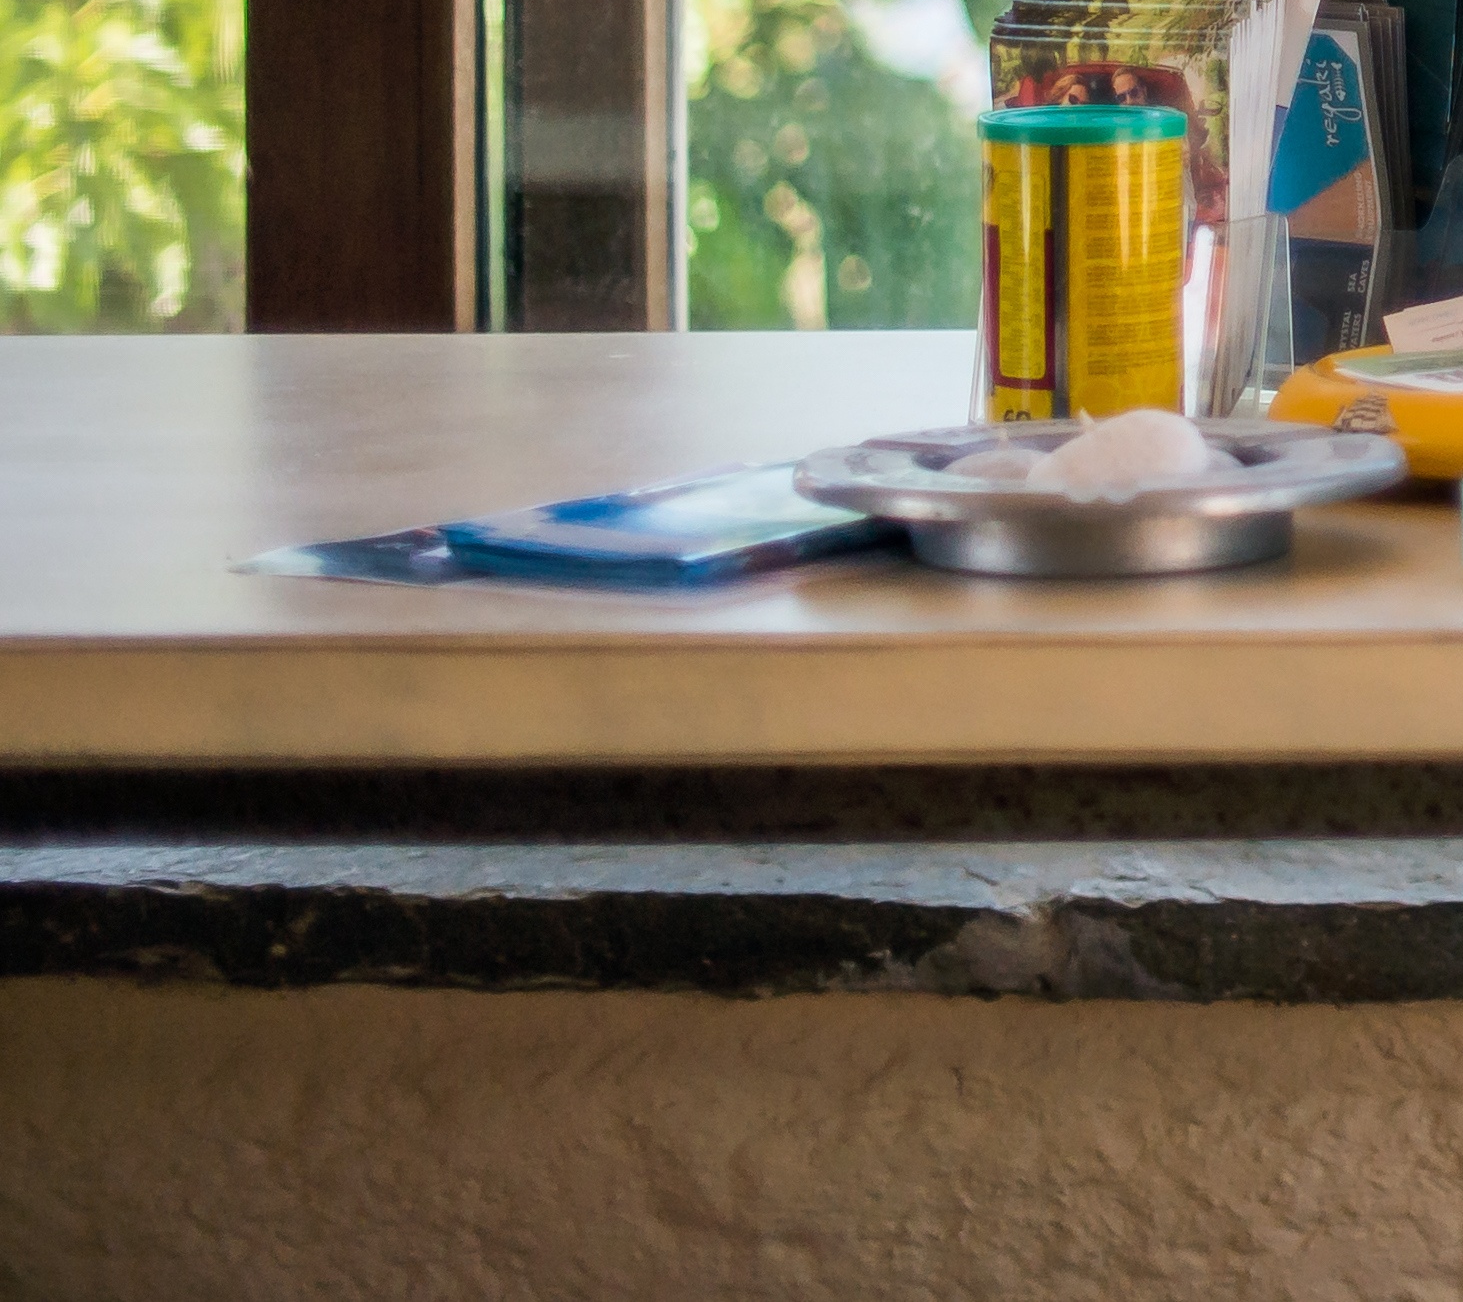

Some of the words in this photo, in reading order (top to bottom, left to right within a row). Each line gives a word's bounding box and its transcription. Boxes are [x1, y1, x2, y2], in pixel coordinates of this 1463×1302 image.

[1347, 272, 1358, 294] SEA
[1358, 259, 1370, 294] CAVES
[1338, 310, 1351, 351] RYSTAL
